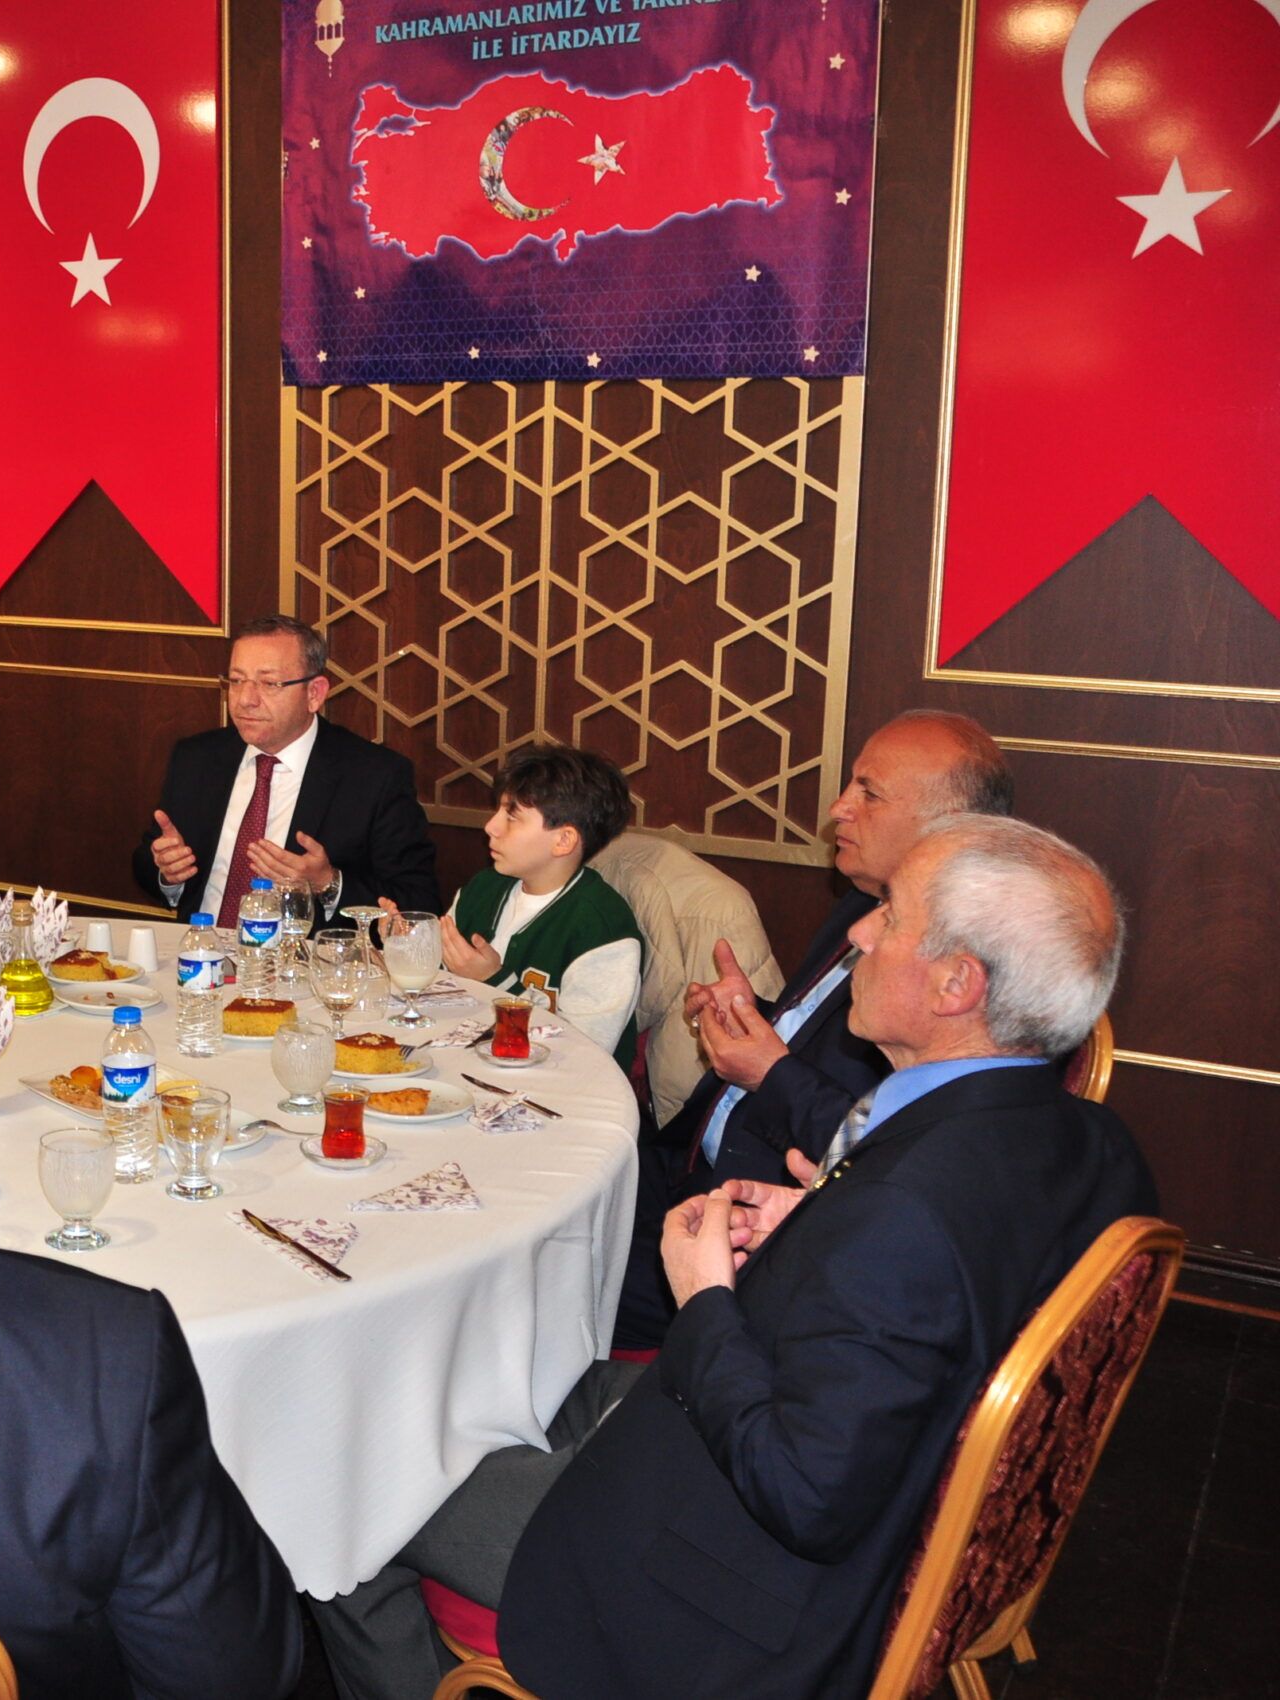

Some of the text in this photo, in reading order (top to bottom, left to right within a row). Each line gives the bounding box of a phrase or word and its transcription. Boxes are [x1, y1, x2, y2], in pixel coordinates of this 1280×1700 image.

[375, 0, 587, 43] KAHRAMANLARIMIZ
[472, 23, 641, 60] İLE İFTARDAYIZ
